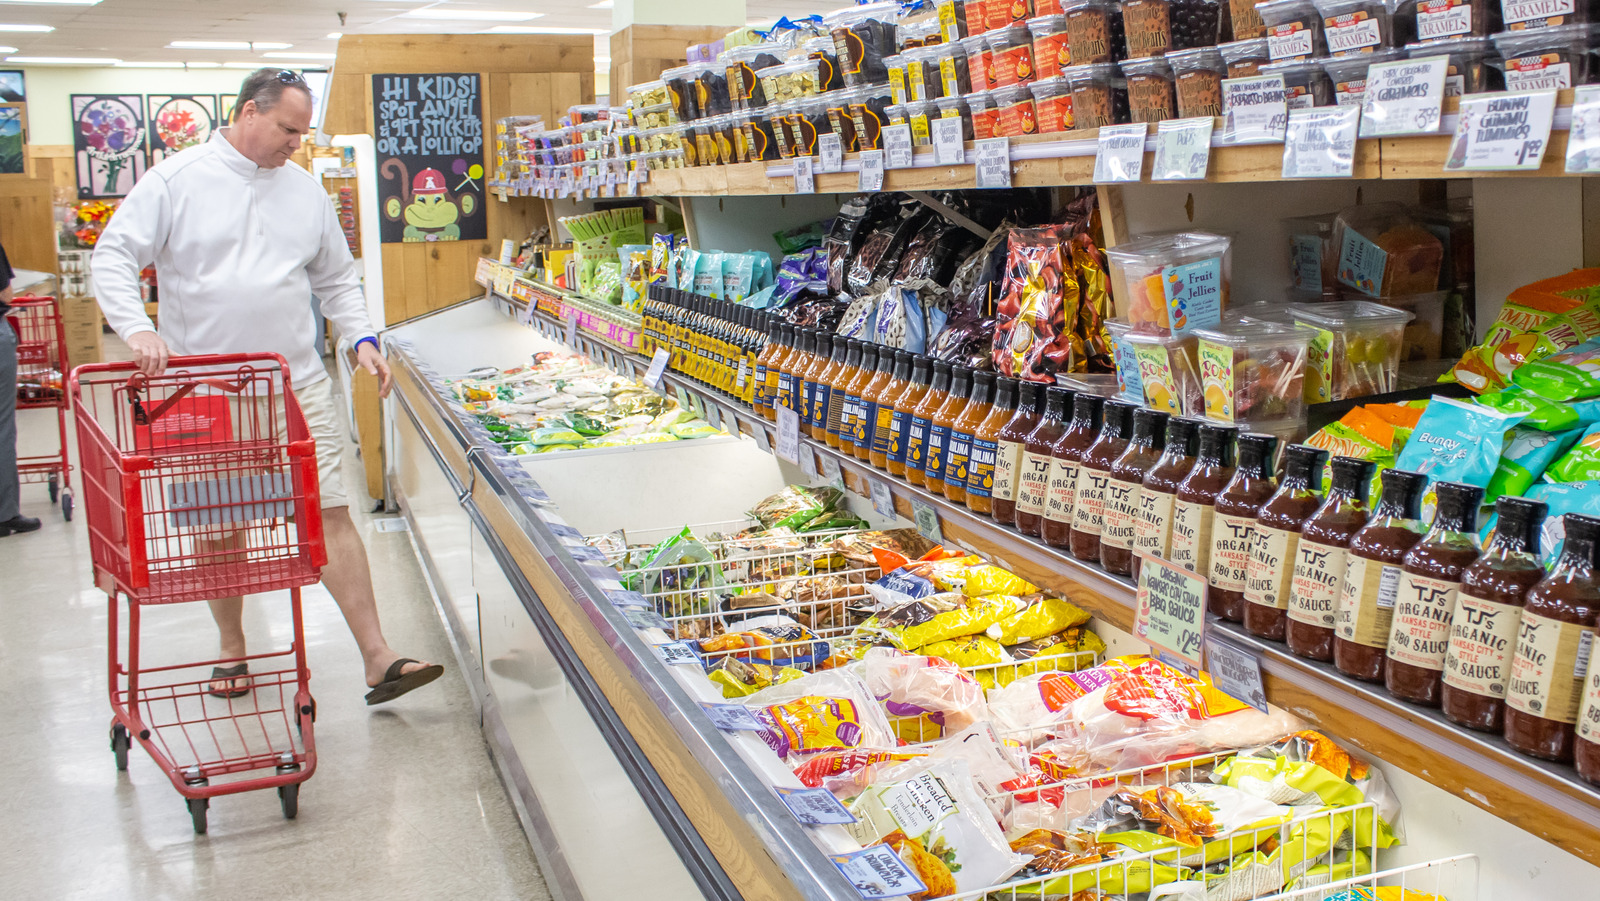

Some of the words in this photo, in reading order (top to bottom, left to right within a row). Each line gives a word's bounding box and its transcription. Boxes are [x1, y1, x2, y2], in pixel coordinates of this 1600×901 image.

[1143, 31, 1167, 47] Beans
[382, 77, 409, 100] HI
[417, 76, 476, 100] KIDS!
[379, 100, 418, 119] SPOT
[1487, 96, 1530, 113] BUNNY
[1480, 111, 1528, 127] GUMMY
[379, 120, 390, 137] &
[422, 118, 482, 137] STICKERS
[377, 137, 400, 156] OR
[401, 137, 418, 155] A
[420, 136, 483, 155] LOLLIPOP
[1354, 241, 1365, 271] Jellies
[1188, 271, 1213, 285] Fruit
[1187, 285, 1217, 300] Jellies
[982, 441, 996, 449] JOE'S
[1418, 432, 1460, 451] Bunny
[1023, 473, 1047, 483] ORGA
[1052, 479, 1075, 489] ORGA
[1055, 488, 1073, 496] KANSAS
[1080, 489, 1103, 499] ORGA
[1049, 498, 1061, 510] BBQ
[1083, 498, 1101, 508] KANSAS
[1107, 499, 1138, 517] RGANIC
[1077, 508, 1089, 521] BBQ
[1107, 518, 1120, 527] STYLE
[1118, 513, 1129, 521] CITY
[1109, 526, 1135, 538] SAUCE
[1175, 523, 1194, 539] ANIC
[1173, 549, 1191, 561] AUCE
[1220, 551, 1244, 561] KANSAS
[1251, 550, 1278, 567] ANIC
[1301, 548, 1332, 568] TJ's
[1215, 562, 1229, 578] BBQ
[1229, 560, 1248, 570] STYLE
[1256, 563, 1267, 572] CITY
[1160, 566, 1187, 589] ORGANIC
[1295, 565, 1337, 587] RGANIC
[1169, 585, 1182, 602] CITY
[1298, 588, 1313, 598] STYLE
[1312, 581, 1326, 591] CITY
[1409, 579, 1452, 607] TJ's
[1150, 590, 1166, 614] BBQ
[1168, 600, 1195, 624] SAUCE
[1299, 599, 1332, 612] SAUCE
[1480, 604, 1494, 612] JOE'S
[1399, 603, 1453, 626] ORGANI
[1460, 600, 1503, 630] TJ's
[1402, 616, 1427, 627] KANSAS
[1429, 622, 1447, 632] CITY
[1410, 627, 1432, 639] STYLE
[1394, 629, 1410, 648] BBQ
[1413, 638, 1448, 654] SAUC
[1453, 639, 1475, 652] KANSAS
[1477, 646, 1494, 657] CITY
[1459, 650, 1479, 664] STYLE
[1518, 645, 1546, 667] ANIC
[1461, 662, 1501, 680] SAUCE
[1520, 660, 1534, 671] CITY
[1588, 704, 1600, 723] BB
[759, 731, 779, 751] BREAS
[919, 774, 953, 812] Breaded
[895, 792, 918, 827] Tenderloin
[877, 853, 907, 879] CHICKEN
